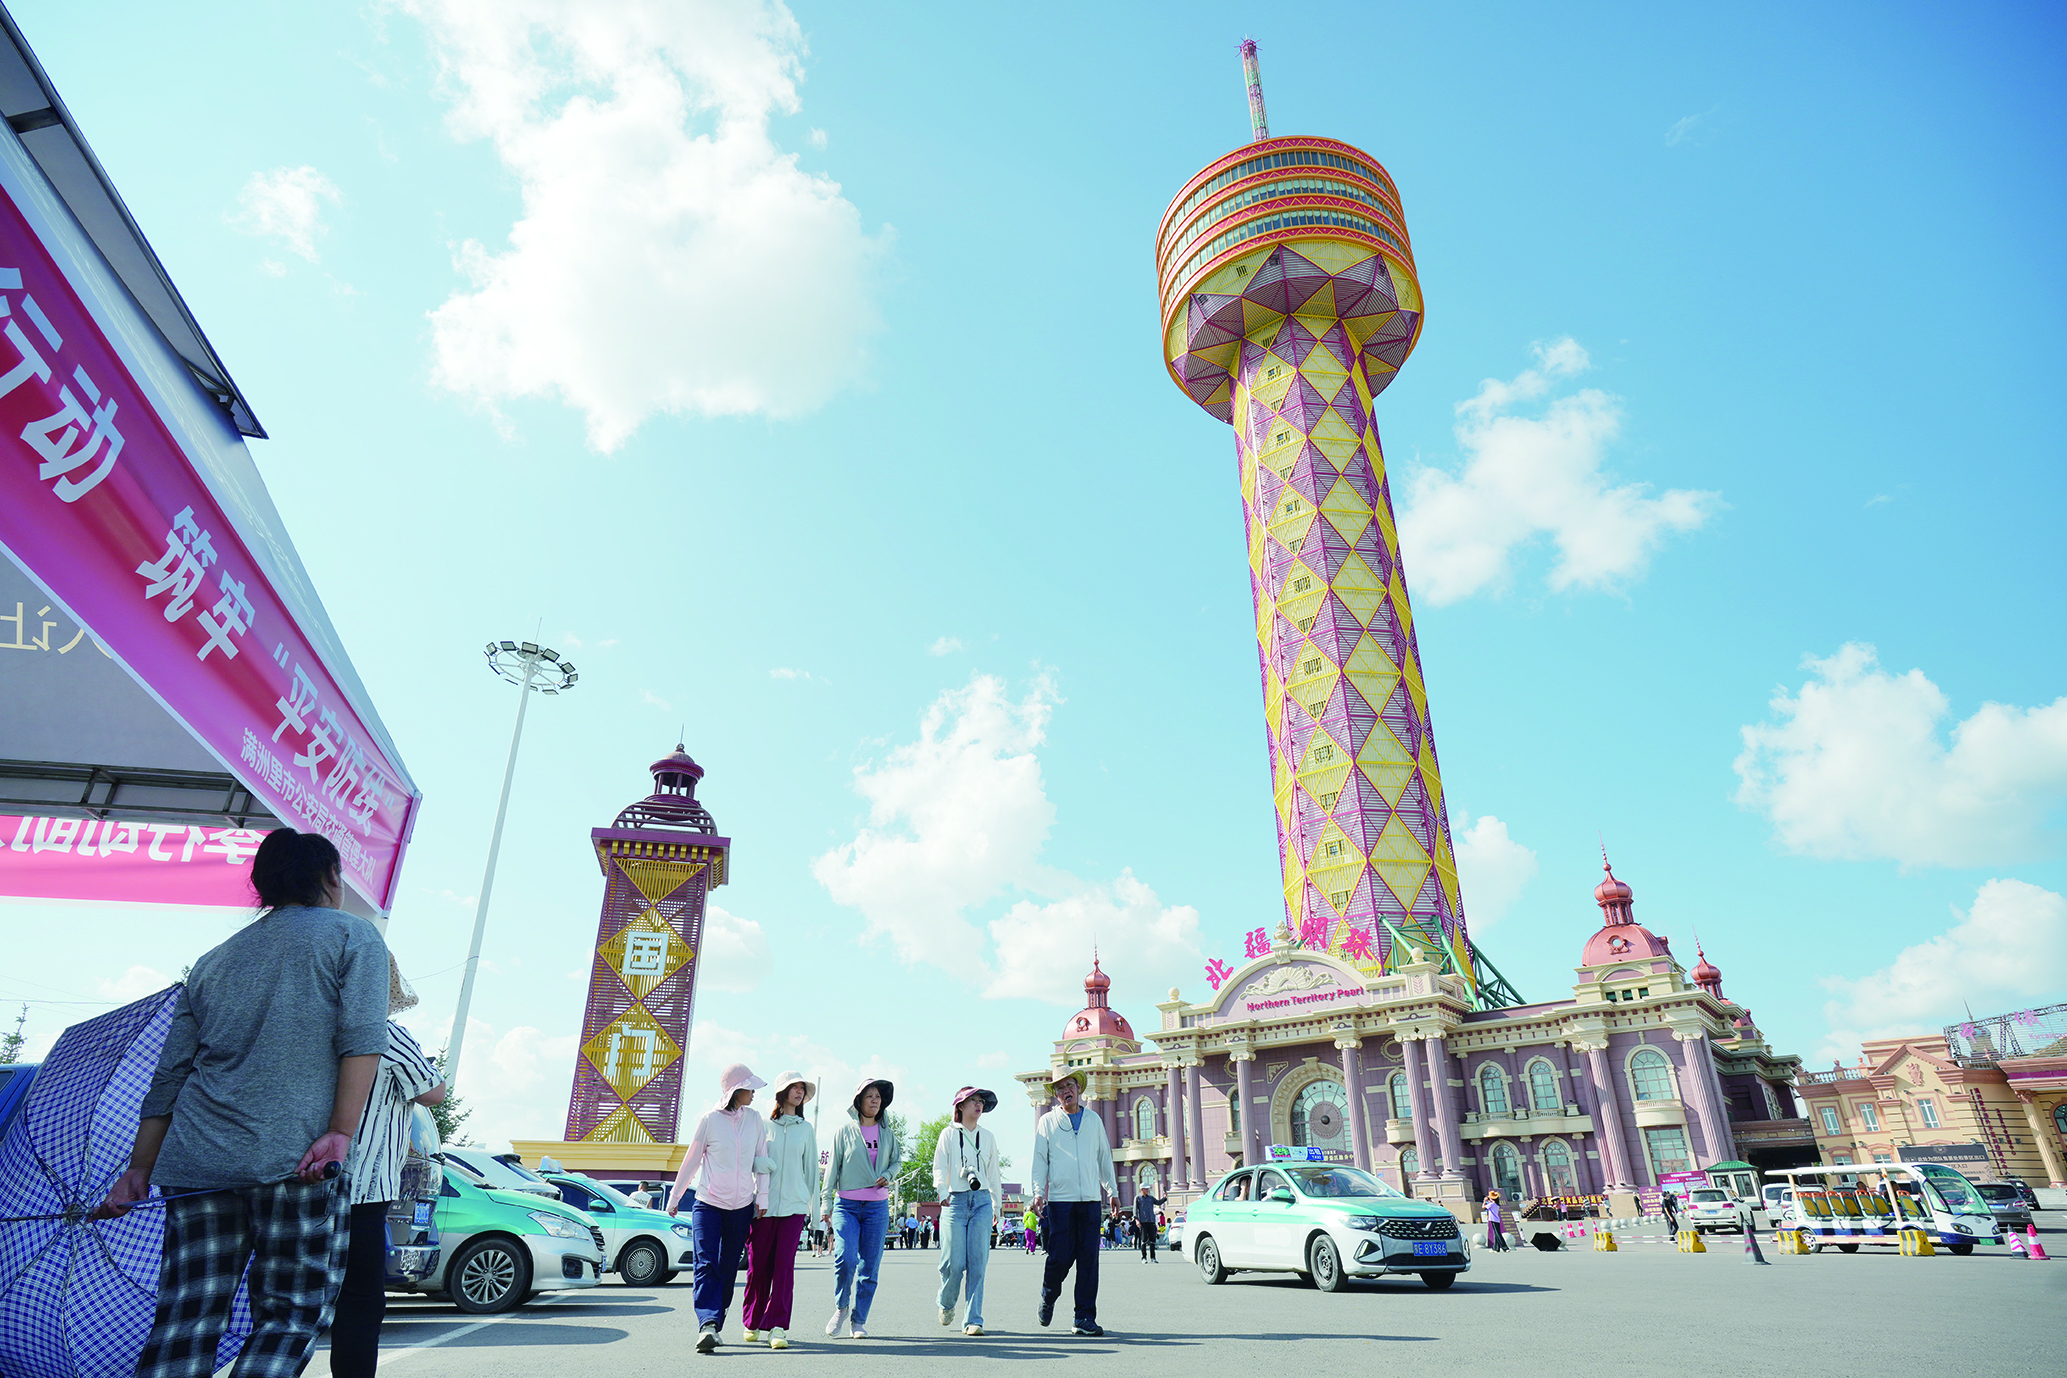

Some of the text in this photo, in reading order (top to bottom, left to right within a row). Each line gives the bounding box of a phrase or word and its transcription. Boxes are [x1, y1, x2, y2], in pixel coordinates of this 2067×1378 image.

[135, 505, 256, 662] 筑牢
[607, 931, 670, 1078] 国门
[1205, 917, 1373, 991] 北疆明珠
[1246, 985, 1364, 1012] Northern Territory Pearl
